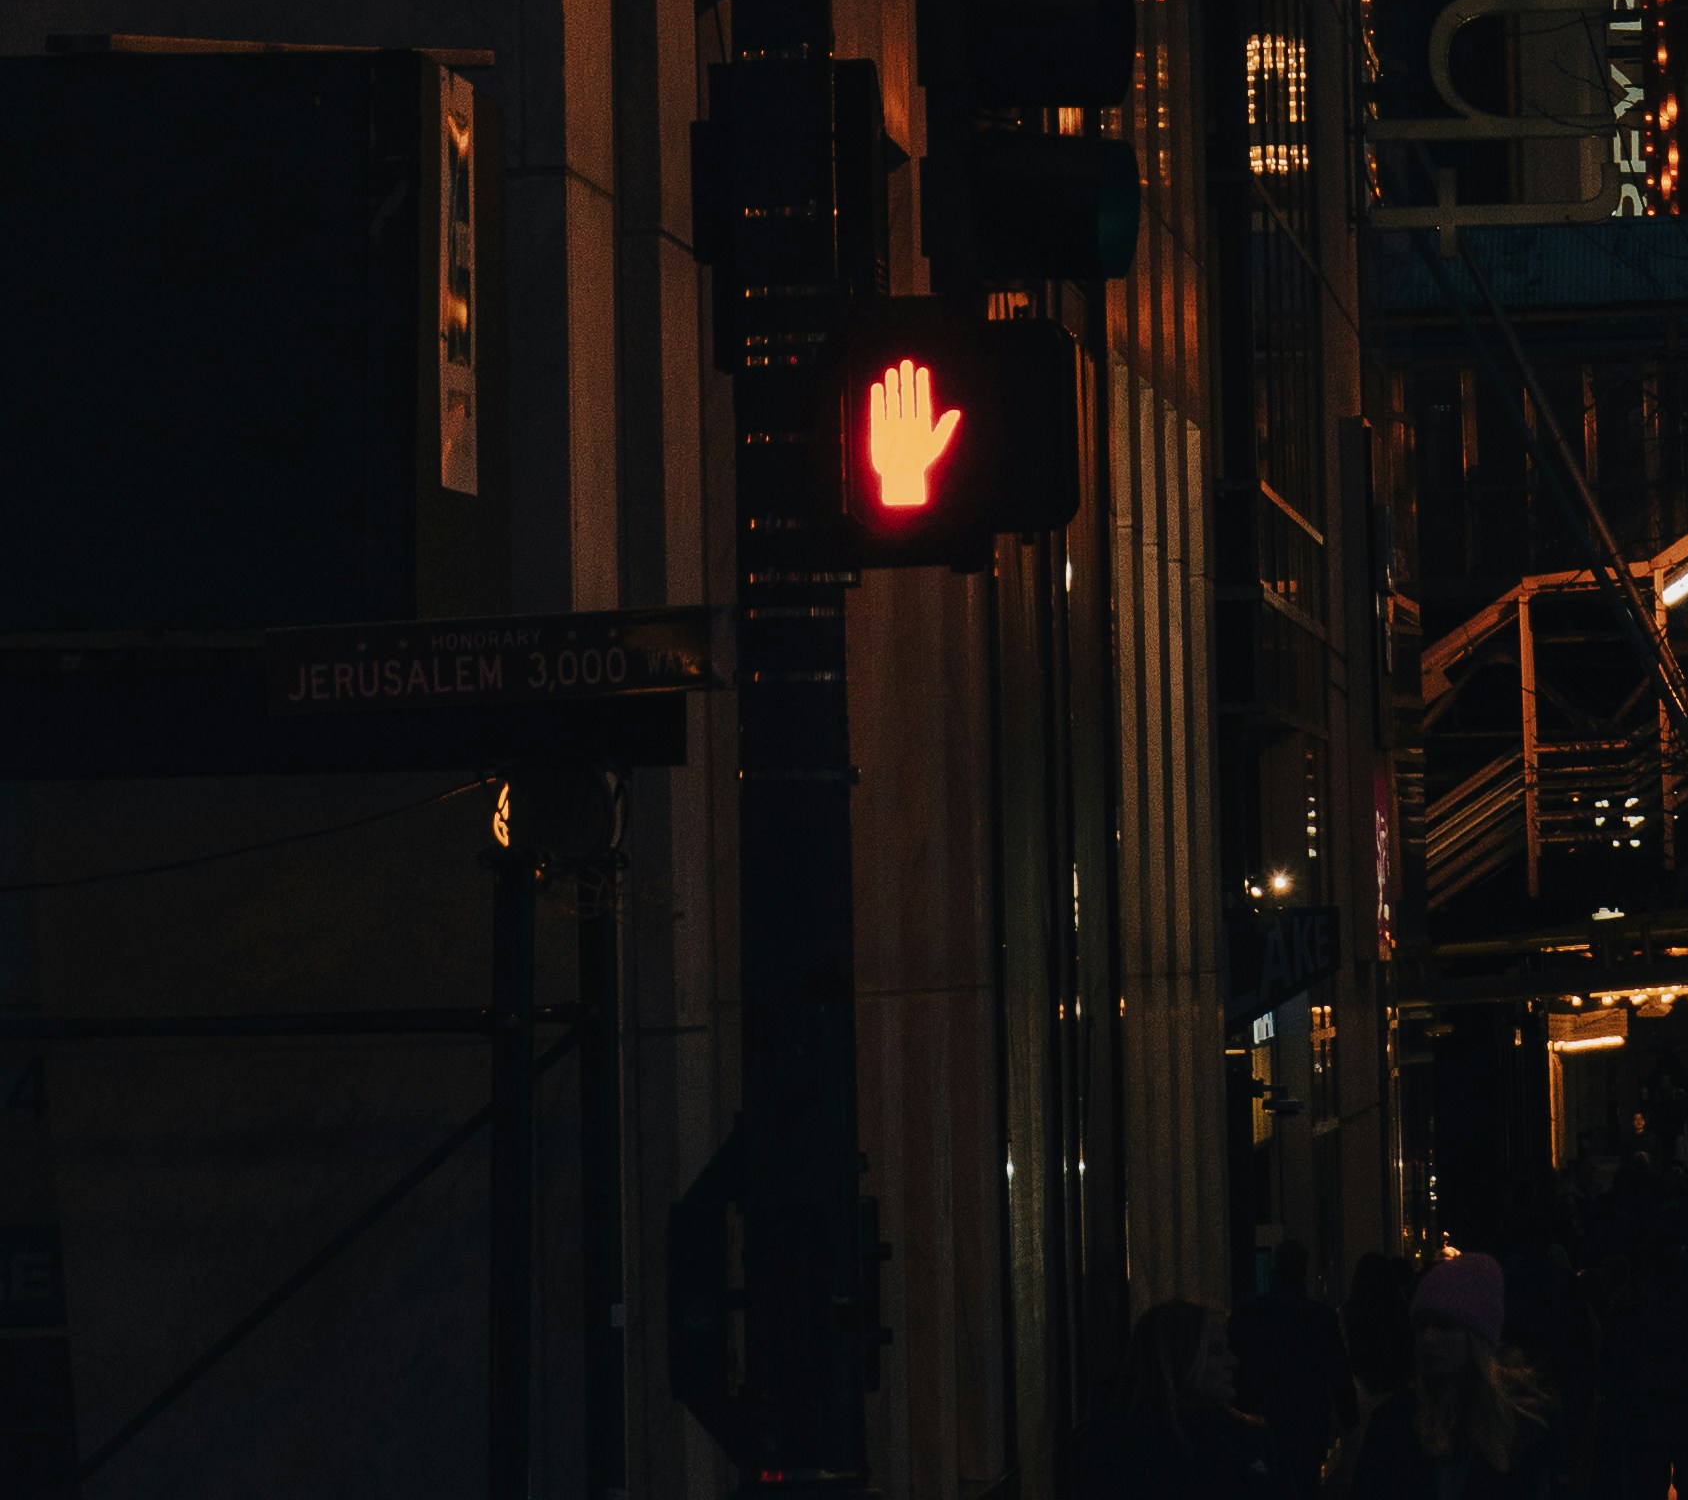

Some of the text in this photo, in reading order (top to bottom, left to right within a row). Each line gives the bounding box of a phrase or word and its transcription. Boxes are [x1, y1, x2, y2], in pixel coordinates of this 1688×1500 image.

[430, 628, 543, 652] HONORARY
[288, 646, 702, 702] JERUSALEM 3,000 WAY
